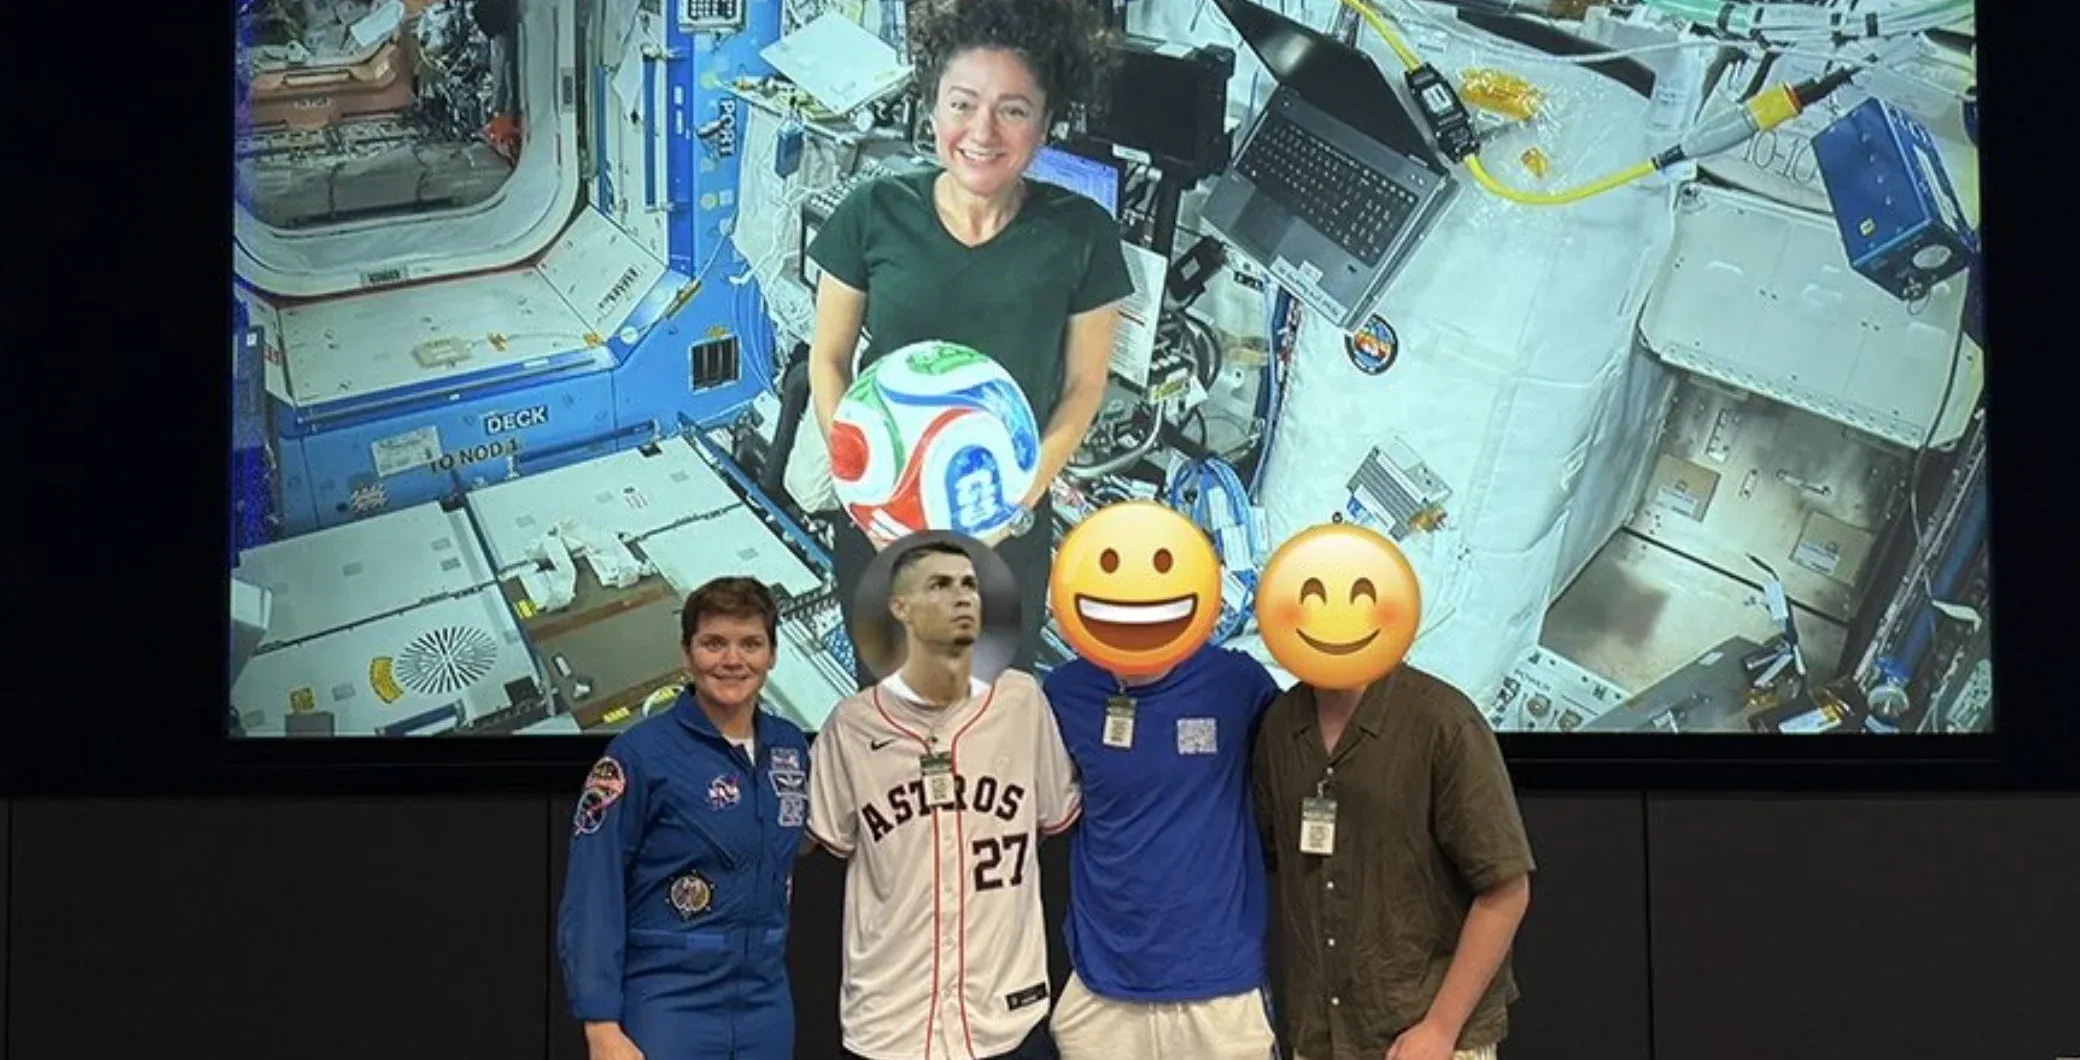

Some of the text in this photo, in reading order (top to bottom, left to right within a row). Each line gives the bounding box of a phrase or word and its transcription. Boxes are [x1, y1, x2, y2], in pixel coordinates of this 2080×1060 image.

[719, 99, 736, 154] PORT
[486, 405, 549, 434] DECK
[459, 442, 504, 465] NOD
[972, 833, 1029, 892] 27
